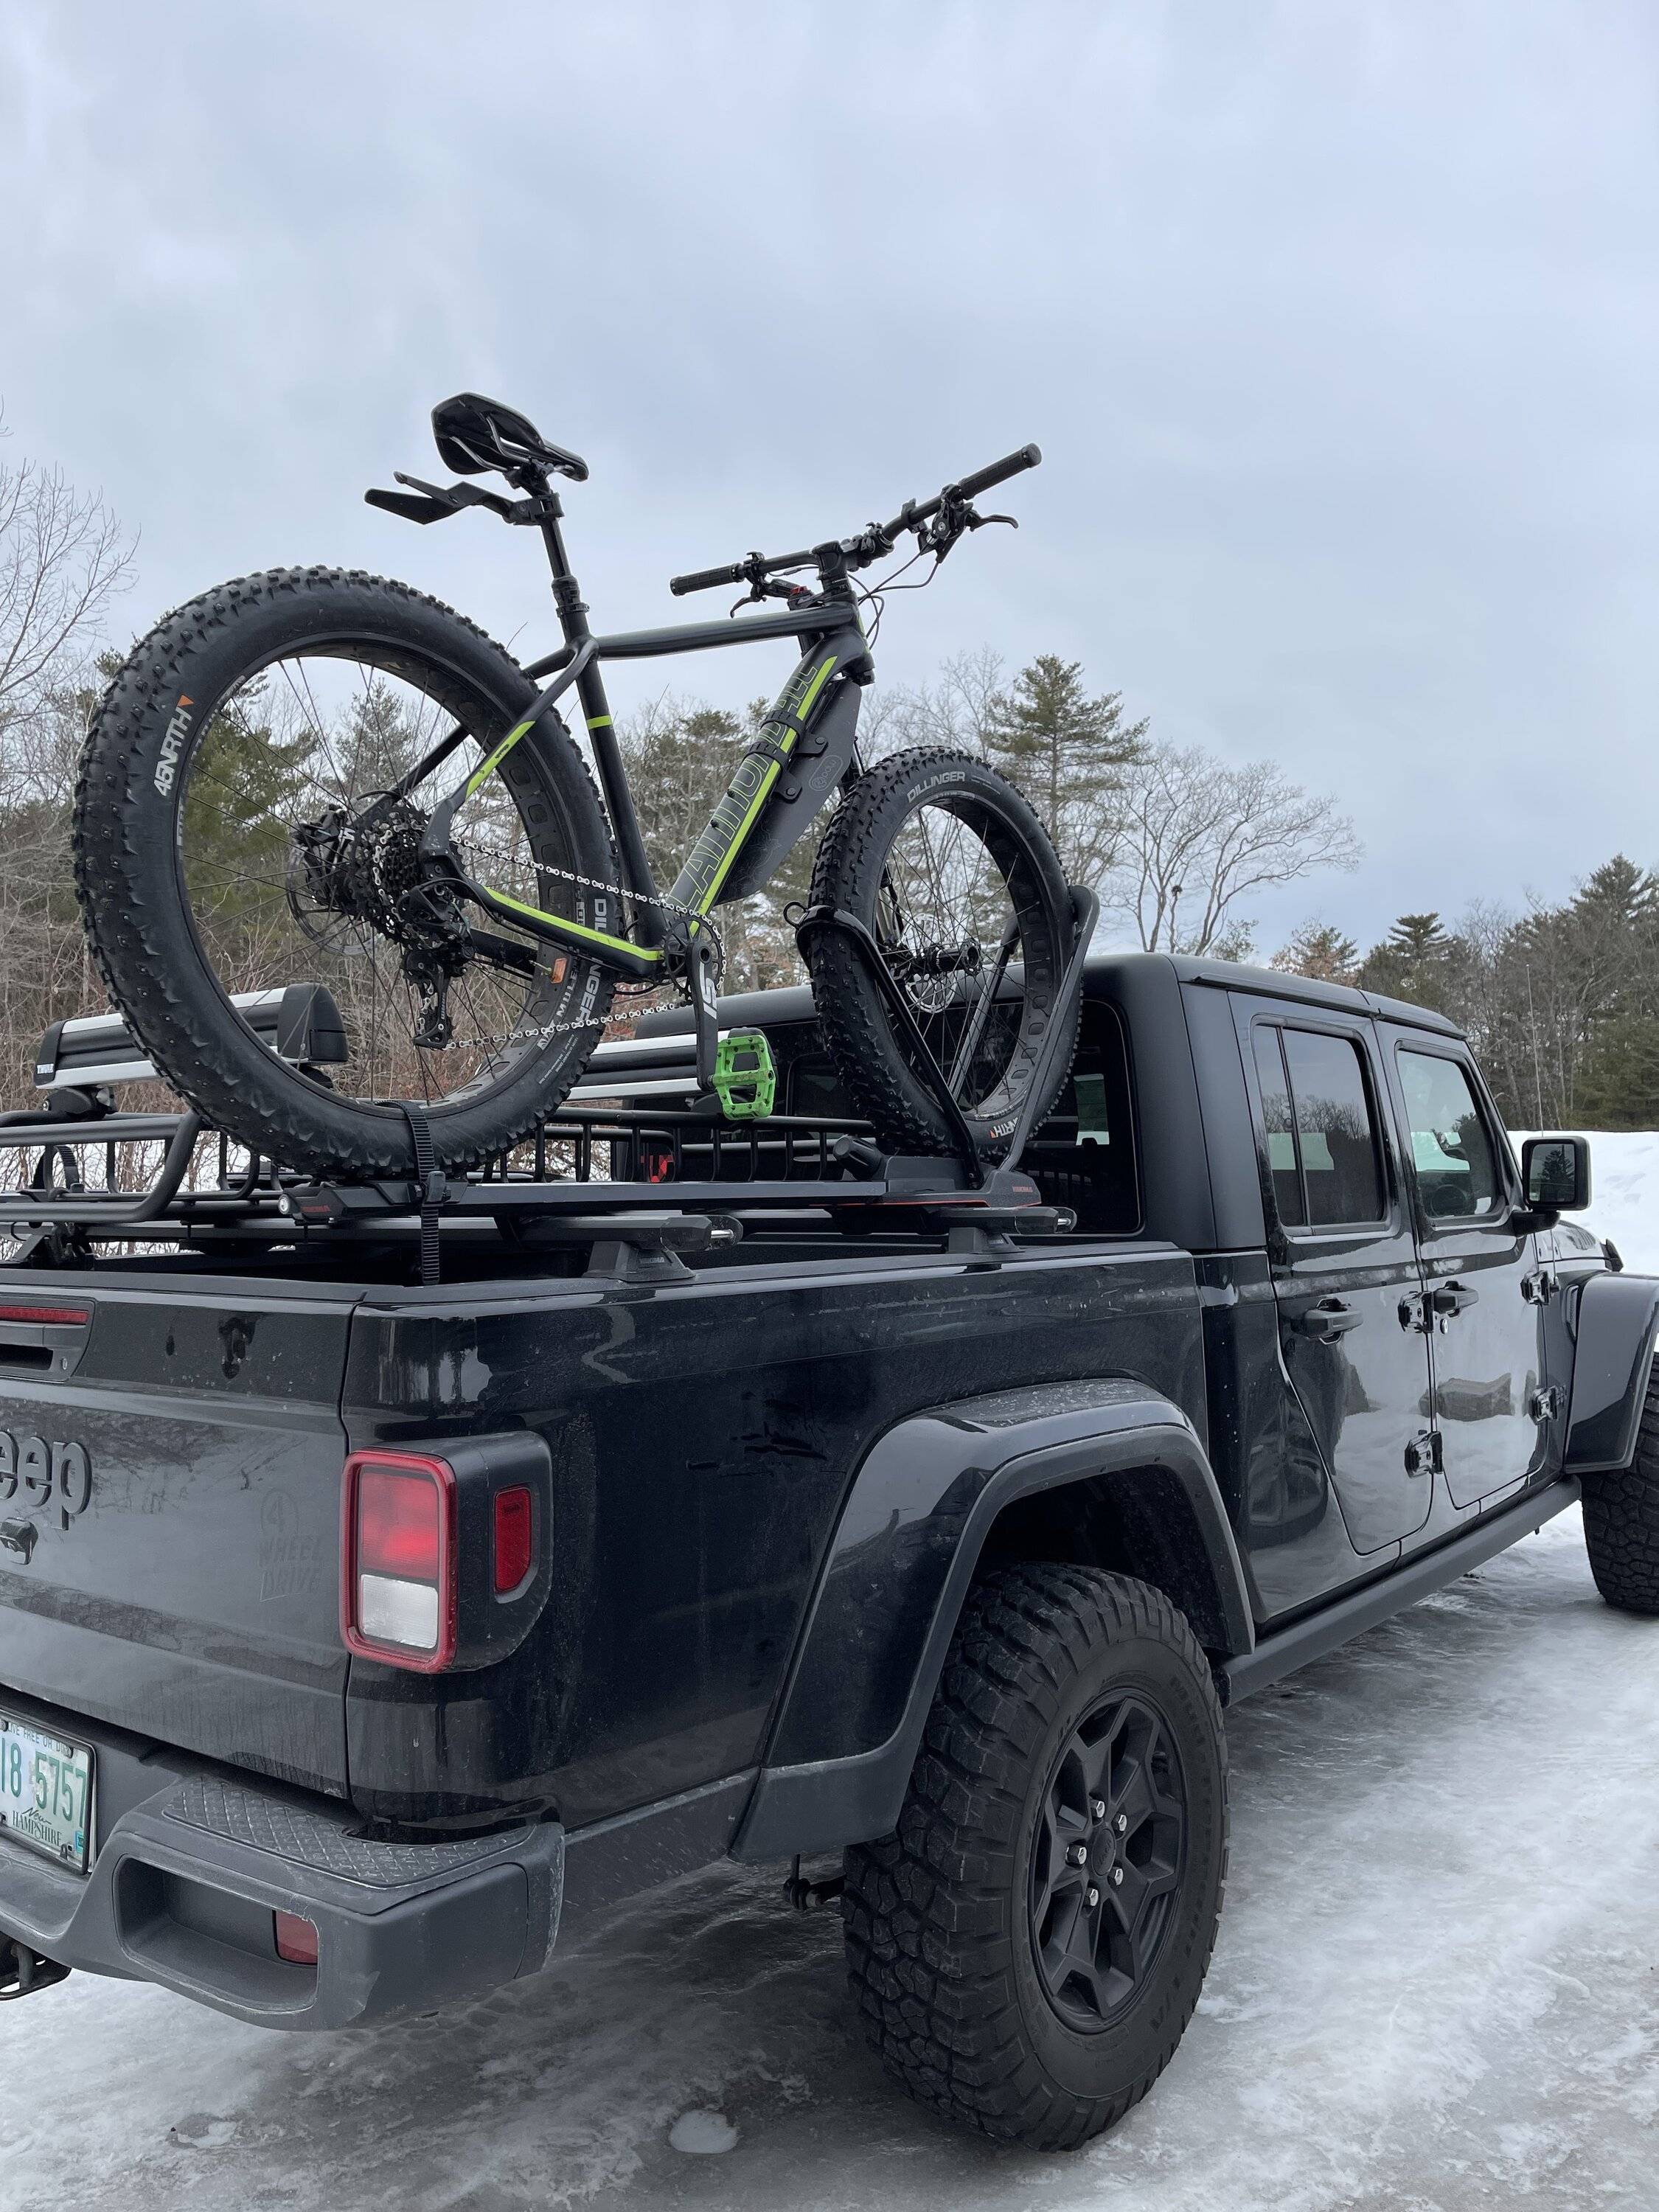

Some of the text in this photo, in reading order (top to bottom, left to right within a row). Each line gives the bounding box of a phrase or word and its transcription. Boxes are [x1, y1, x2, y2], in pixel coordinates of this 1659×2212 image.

[153, 706, 192, 796] 45NRTH
[906, 771, 965, 803] DILLINGER
[576, 898, 607, 1022] DILNGER
[37, 1063, 54, 1074] THULE
[994, 1116, 1018, 1138] NRTH
[0, 1430, 92, 1531] eep
[24, 1726, 40, 1743] FREE
[43, 1736, 53, 1749] OR
[35, 1750, 86, 1828] 5757
[13, 1809, 62, 1847] HAMPSHIRE
